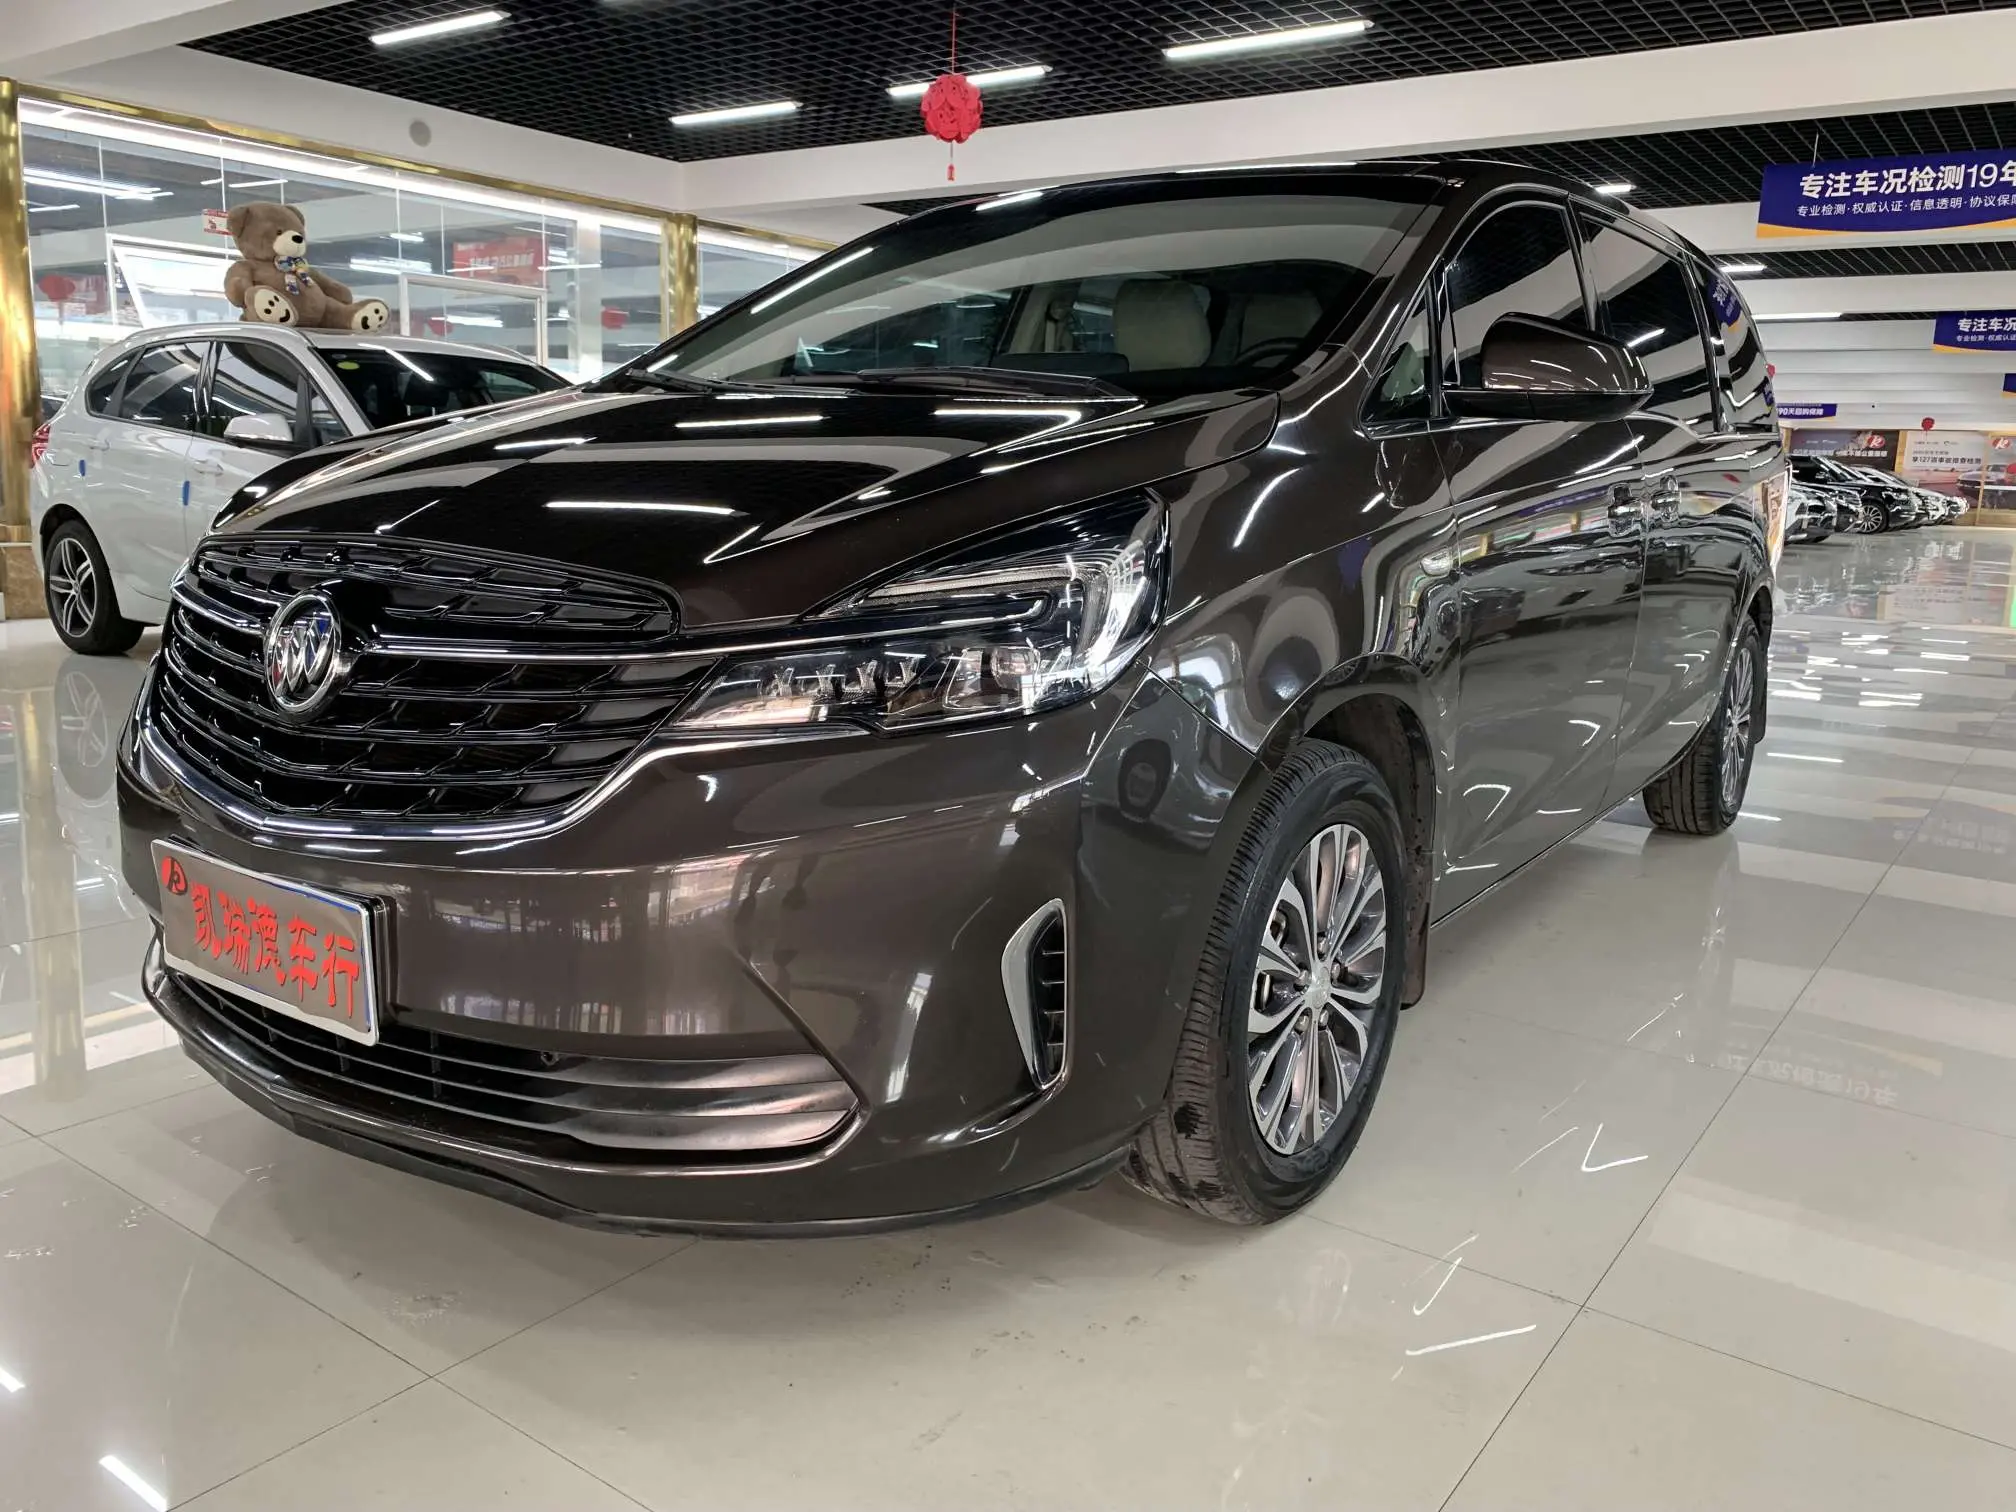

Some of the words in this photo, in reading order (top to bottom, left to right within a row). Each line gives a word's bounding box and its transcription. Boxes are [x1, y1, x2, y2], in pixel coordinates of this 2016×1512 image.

[1799, 159, 2016, 199] 专注车况检测19年
[1957, 317, 2016, 332] 专注车况
